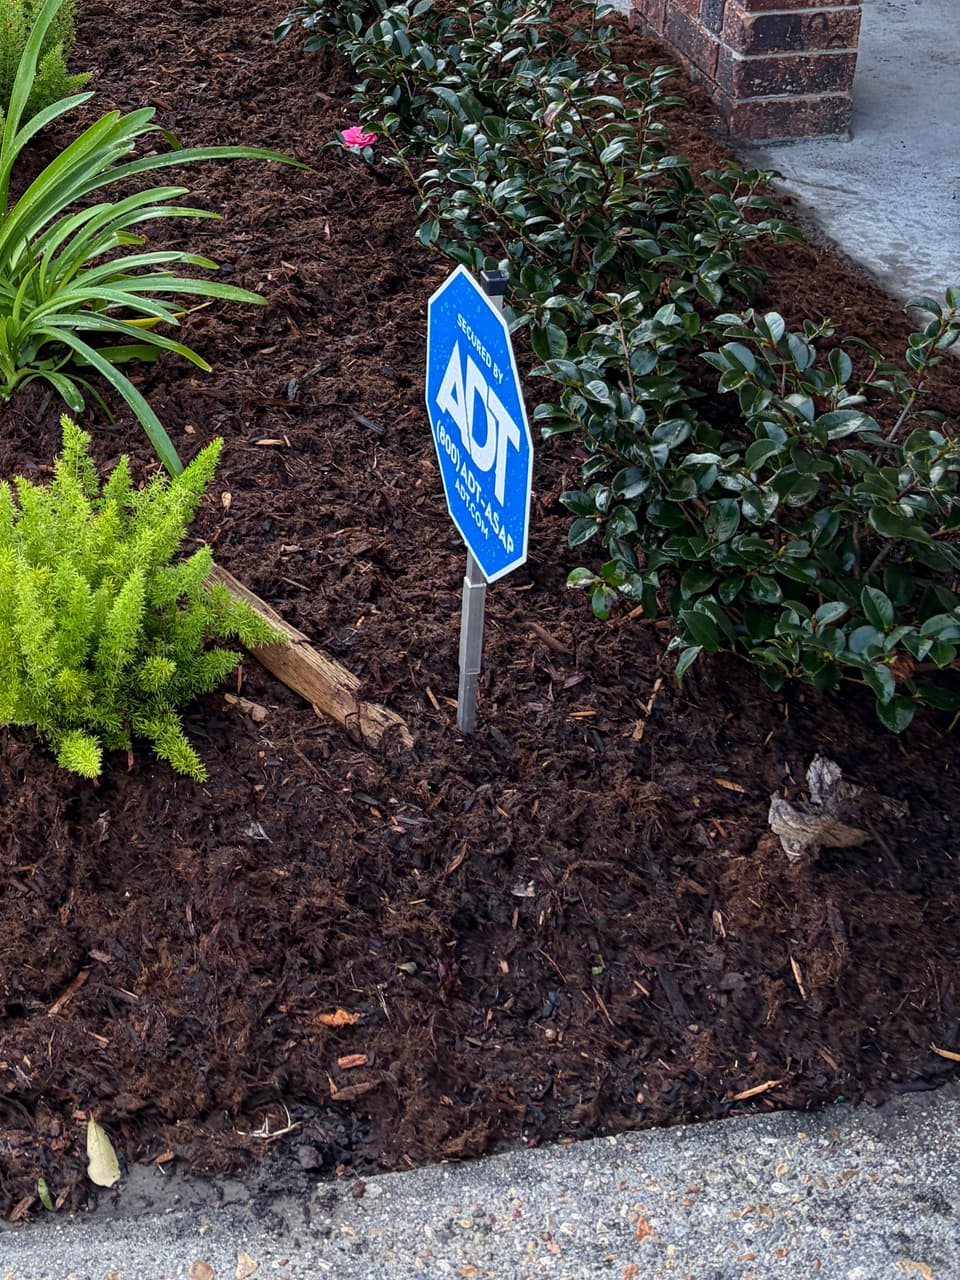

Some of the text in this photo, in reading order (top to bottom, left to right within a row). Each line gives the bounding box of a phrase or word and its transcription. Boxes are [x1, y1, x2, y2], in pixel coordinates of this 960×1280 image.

[456, 313, 504, 385] SECURED BY
[436, 339, 521, 507] ADT
[436, 419, 515, 554] (800) ADT-ASAP
[454, 478, 489, 541] ADT.COM
